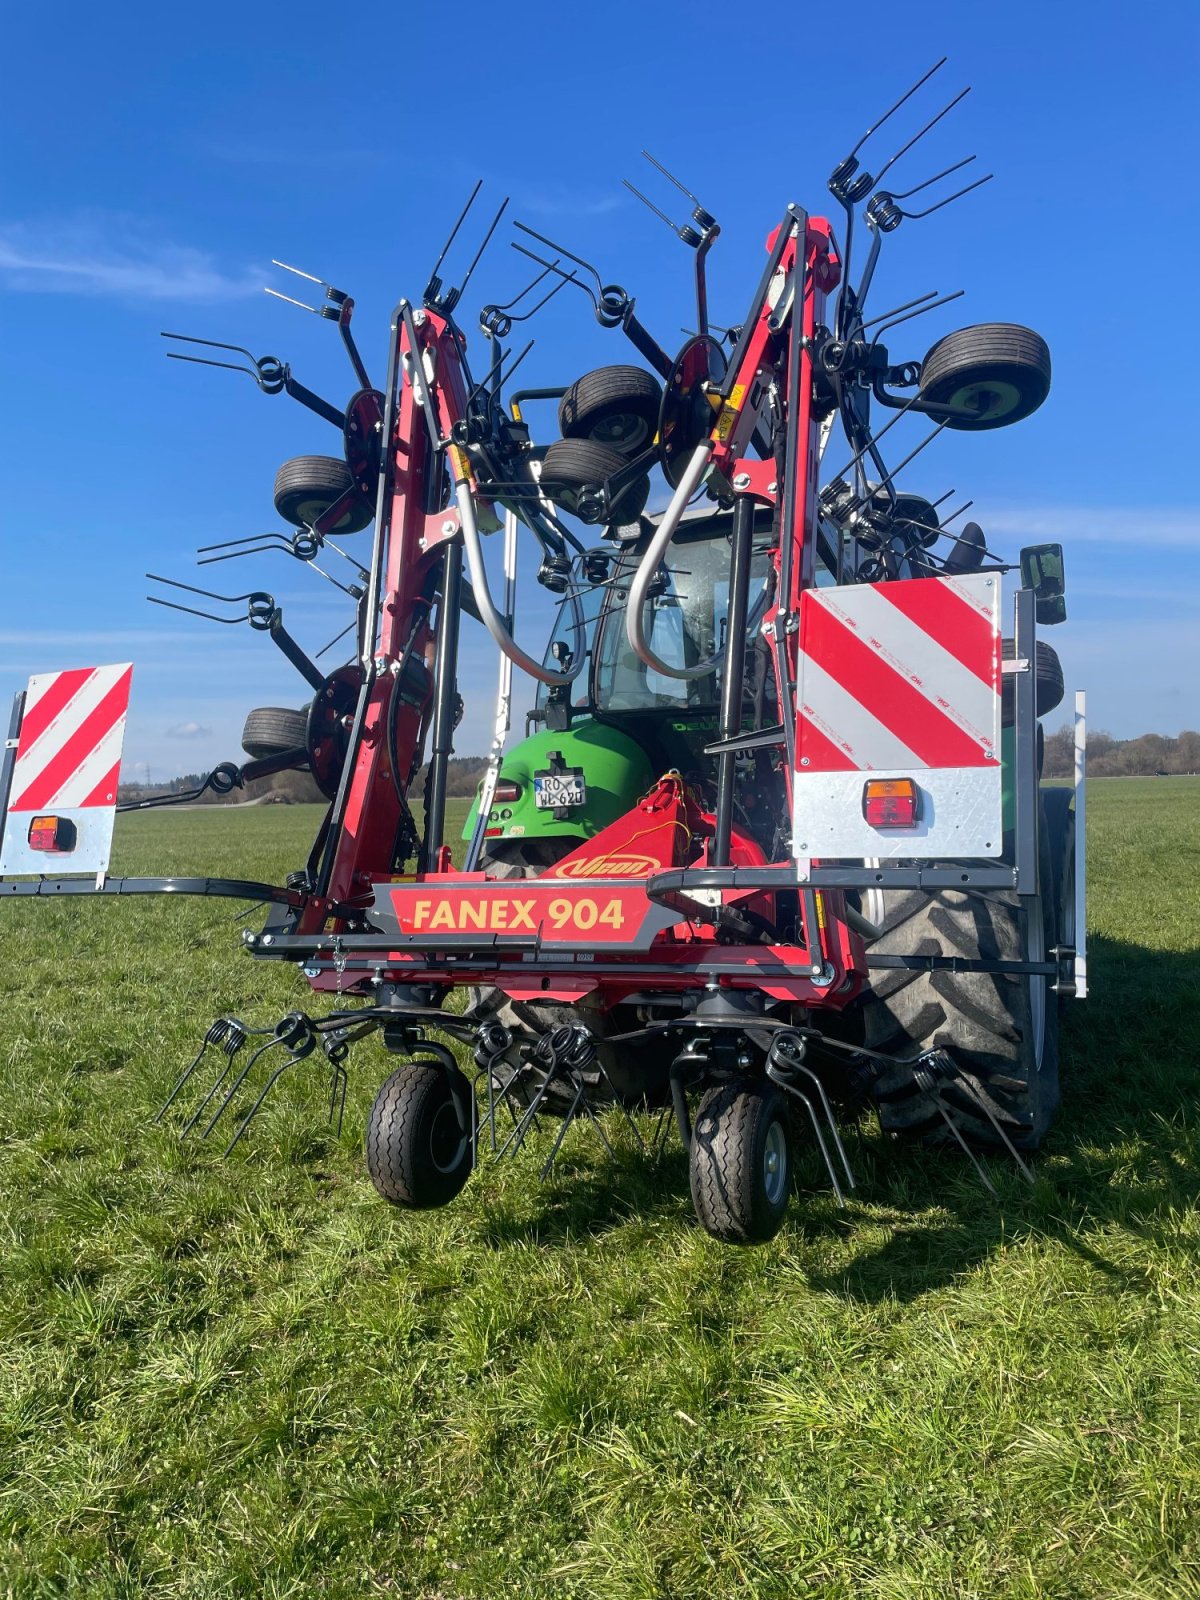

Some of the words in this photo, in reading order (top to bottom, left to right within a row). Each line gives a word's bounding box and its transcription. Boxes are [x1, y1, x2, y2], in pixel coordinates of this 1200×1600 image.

[544, 778, 560, 791] RO
[560, 791, 582, 805] 620
[567, 856, 651, 876] Vicon
[413, 900, 537, 929] FANEX
[548, 899, 625, 929] 904
